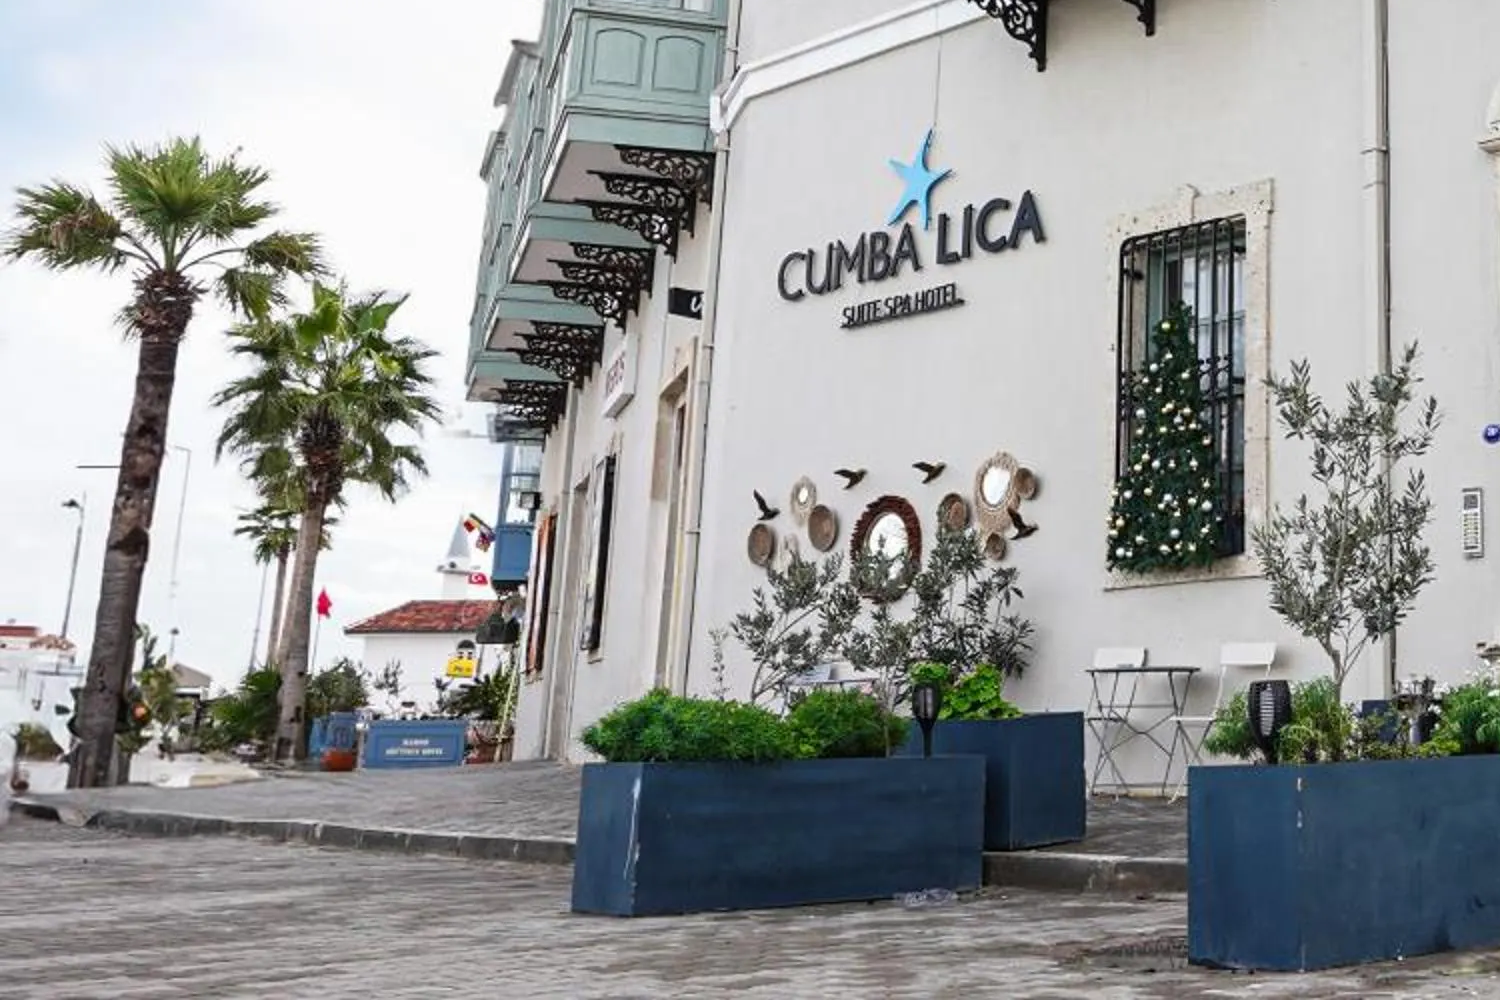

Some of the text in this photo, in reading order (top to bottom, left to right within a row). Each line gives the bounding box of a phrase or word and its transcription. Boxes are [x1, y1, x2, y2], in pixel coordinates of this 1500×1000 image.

[777, 189, 1047, 301] CUMBA LICA
[842, 282, 965, 328] SUITE SPA HOTEL
